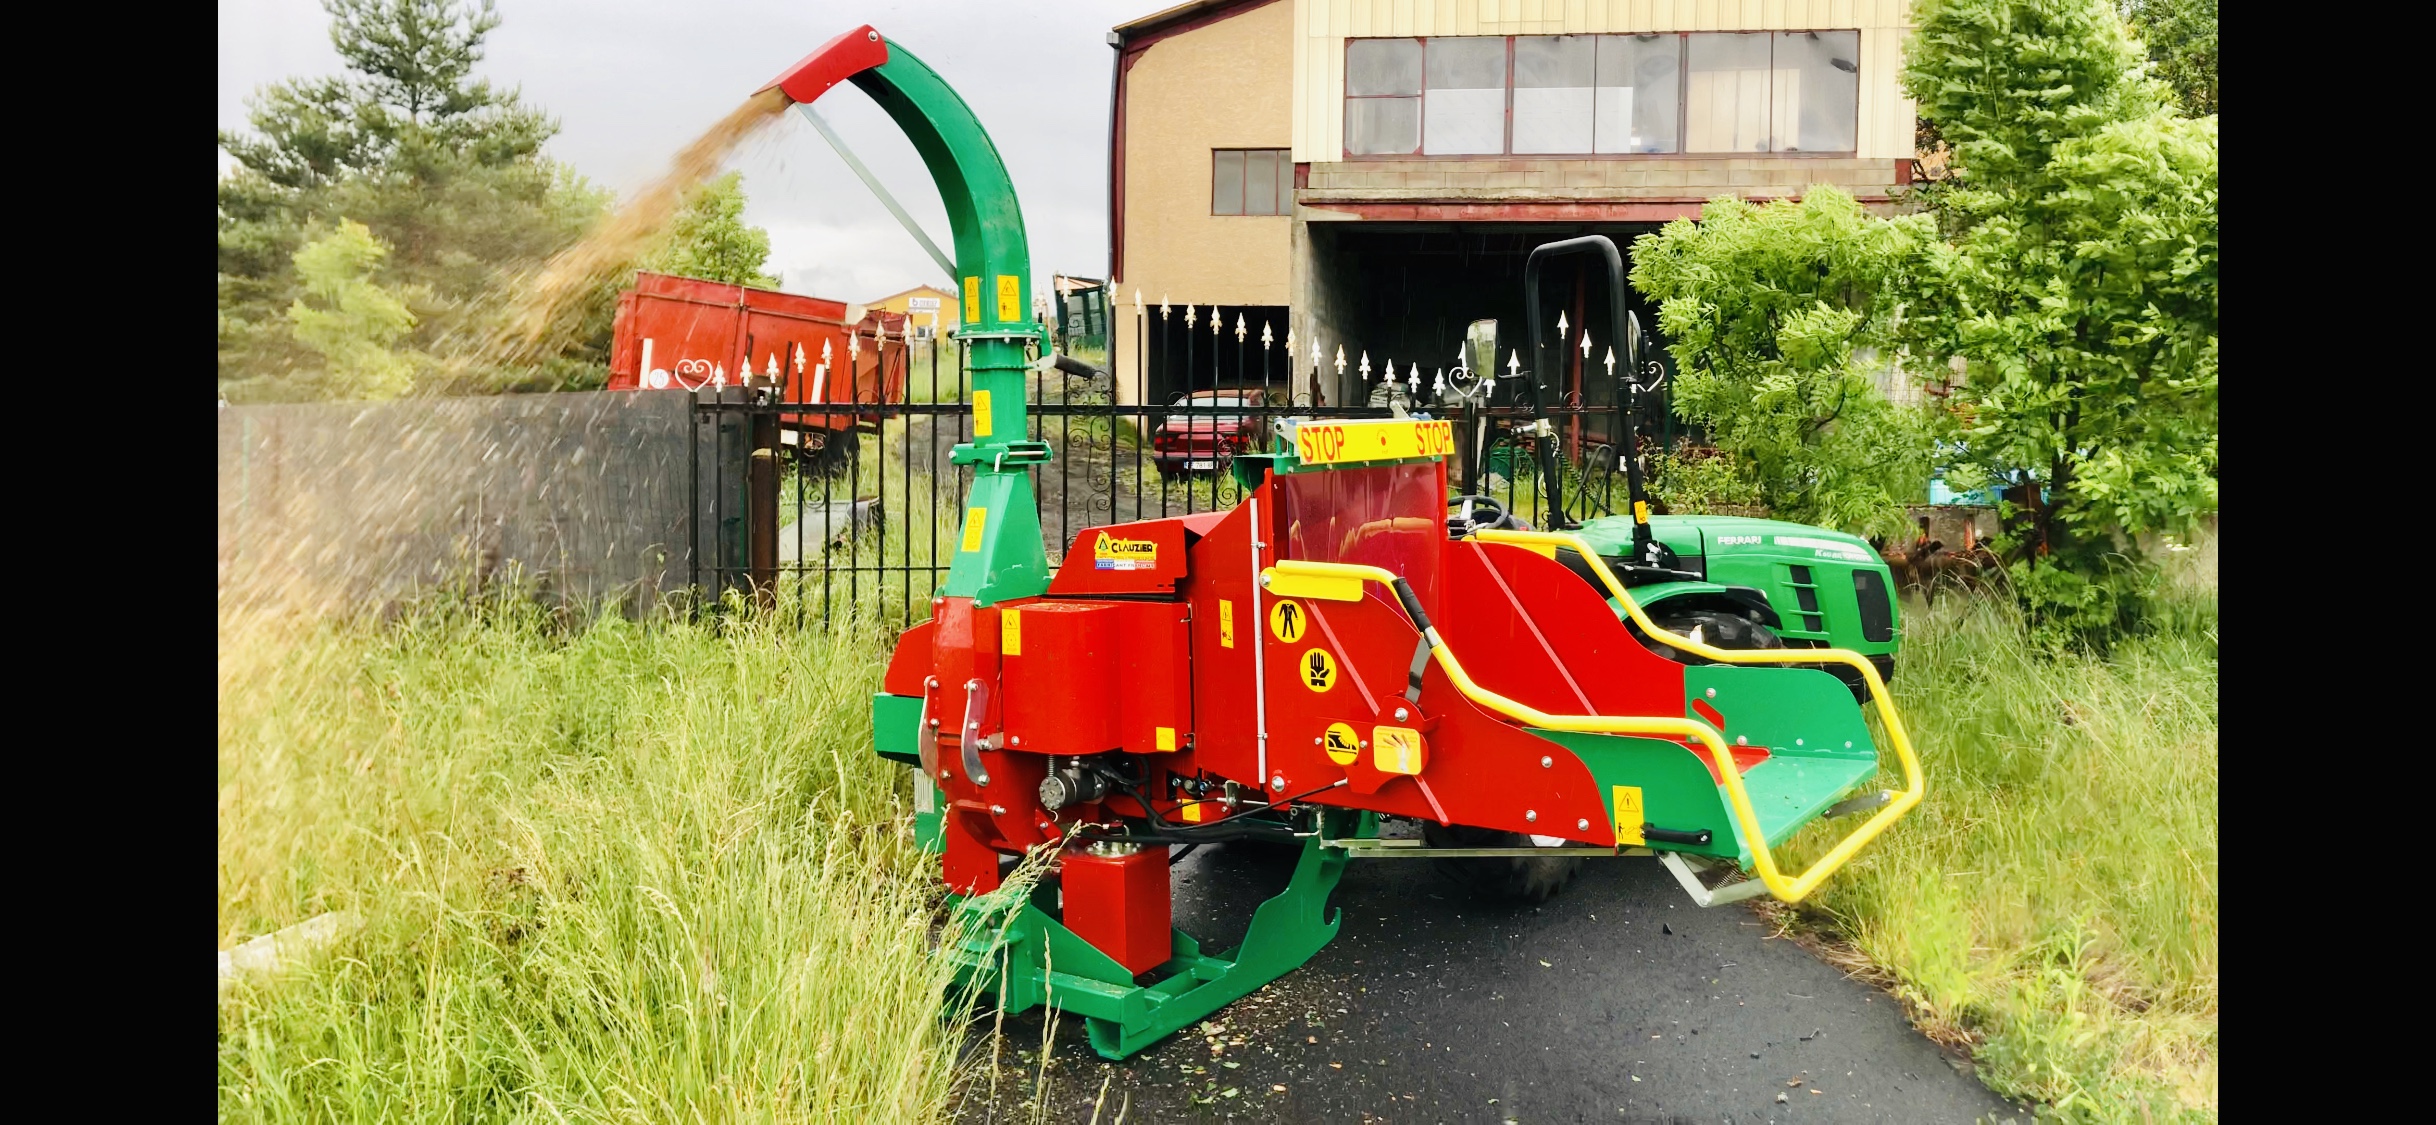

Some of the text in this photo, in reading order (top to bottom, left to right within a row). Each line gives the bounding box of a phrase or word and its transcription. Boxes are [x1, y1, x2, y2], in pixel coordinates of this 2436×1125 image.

[1301, 425, 1344, 463] STOP
[1415, 422, 1450, 456] STOP
[1111, 542, 1153, 553] CLAUZIER
[1717, 536, 1761, 545] FERRARI
